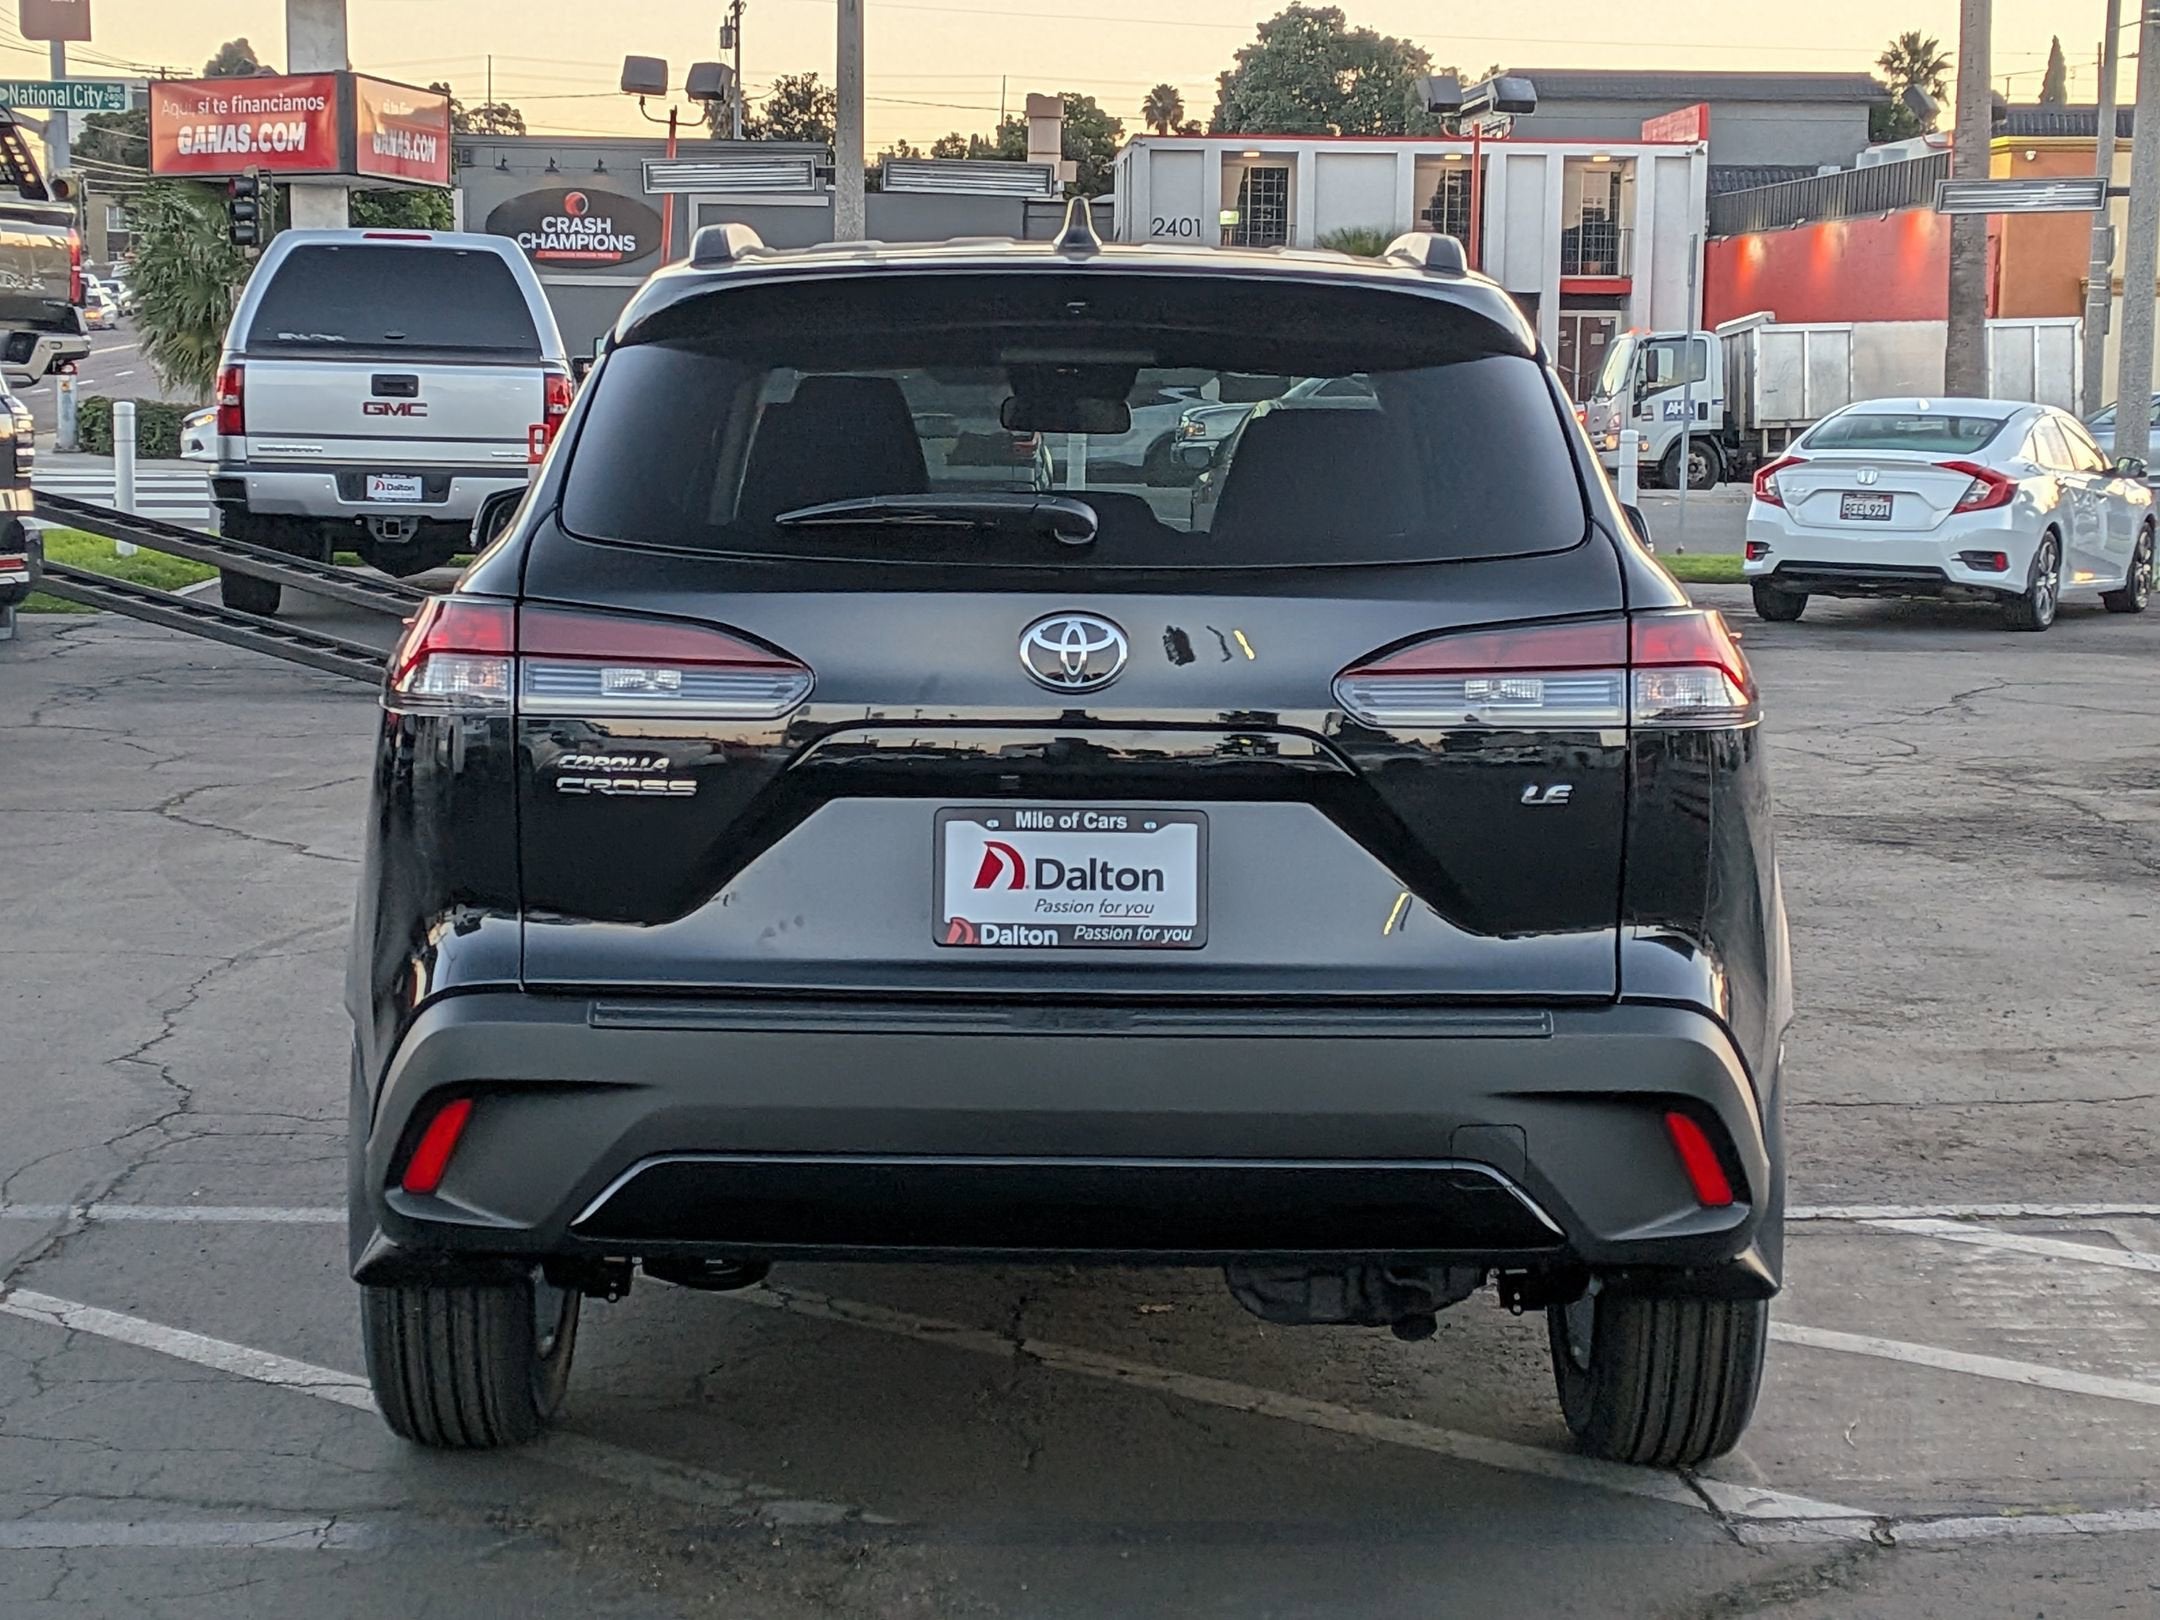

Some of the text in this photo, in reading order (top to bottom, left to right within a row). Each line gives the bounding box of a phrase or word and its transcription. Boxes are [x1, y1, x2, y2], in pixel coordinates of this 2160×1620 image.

[8, 84, 104, 109] National City
[213, 99, 228, 114] te
[231, 93, 325, 114] financiamos
[177, 122, 307, 155] GANAS.COM
[541, 216, 612, 234] CRASH
[1152, 217, 1200, 238] 2401
[517, 232, 636, 252] CHAMPIONS
[362, 401, 428, 417] GMC
[558, 754, 670, 772] COROLLA
[556, 777, 697, 796] CROSS
[1520, 784, 1573, 804] LE
[1015, 811, 1128, 830] Mile of Cars
[1035, 857, 1164, 892] Dalton
[1034, 898, 1155, 917] Passion for you
[980, 923, 1059, 946] Dalton
[1073, 924, 1193, 944] Passion for you
